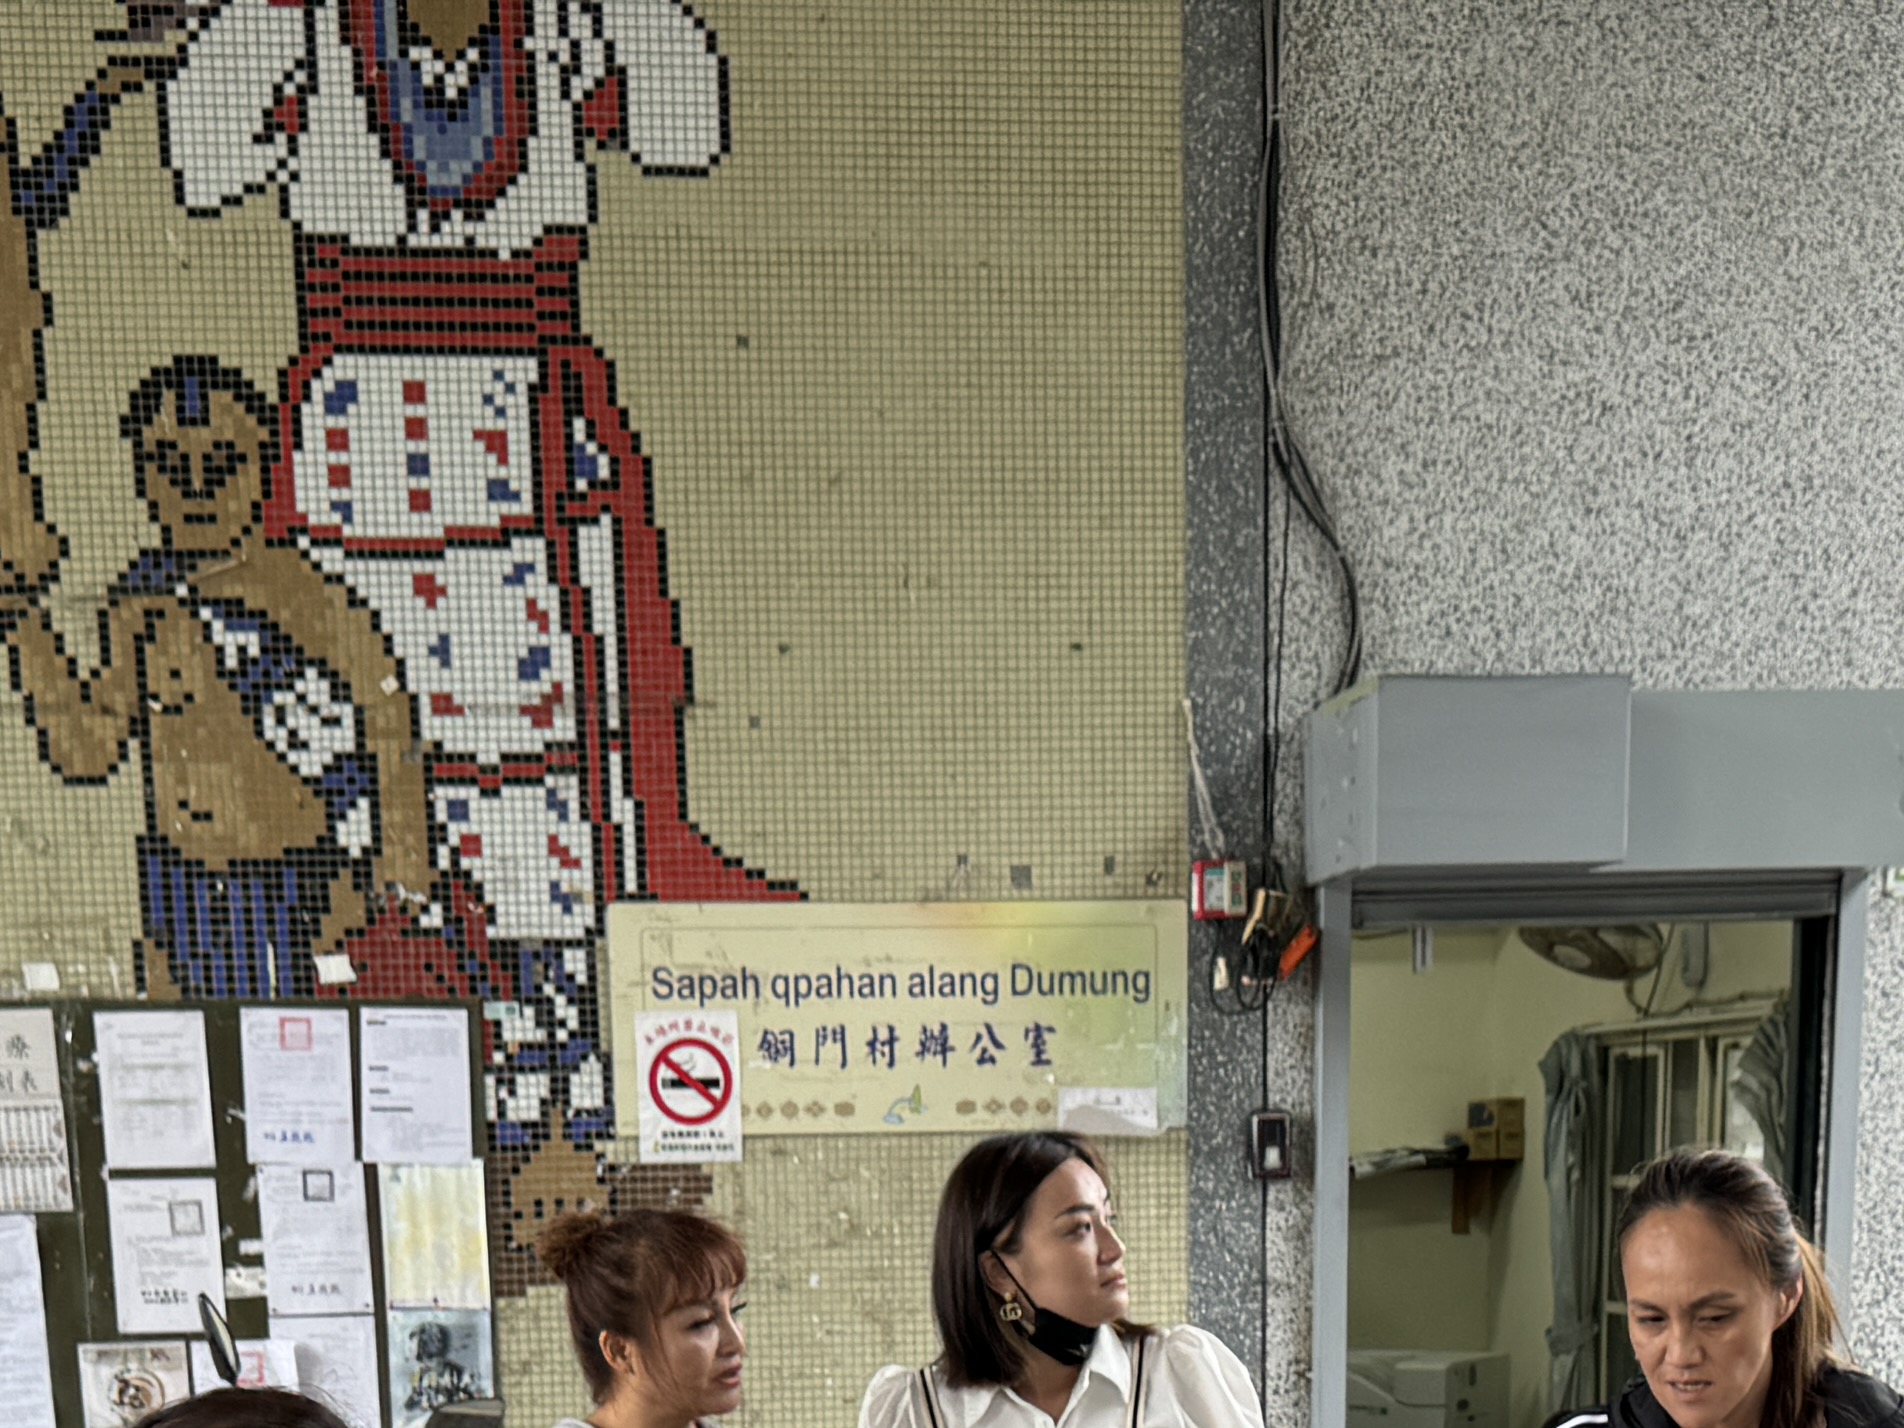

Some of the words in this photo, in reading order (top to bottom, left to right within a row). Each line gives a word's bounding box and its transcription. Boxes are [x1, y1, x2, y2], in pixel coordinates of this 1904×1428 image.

[651, 965, 760, 1006] Sapah
[771, 966, 896, 1007] qpahan
[907, 964, 999, 1005] alang
[1010, 962, 1150, 1003] Dumung
[756, 1021, 1057, 1070] 銅門村辦公室
